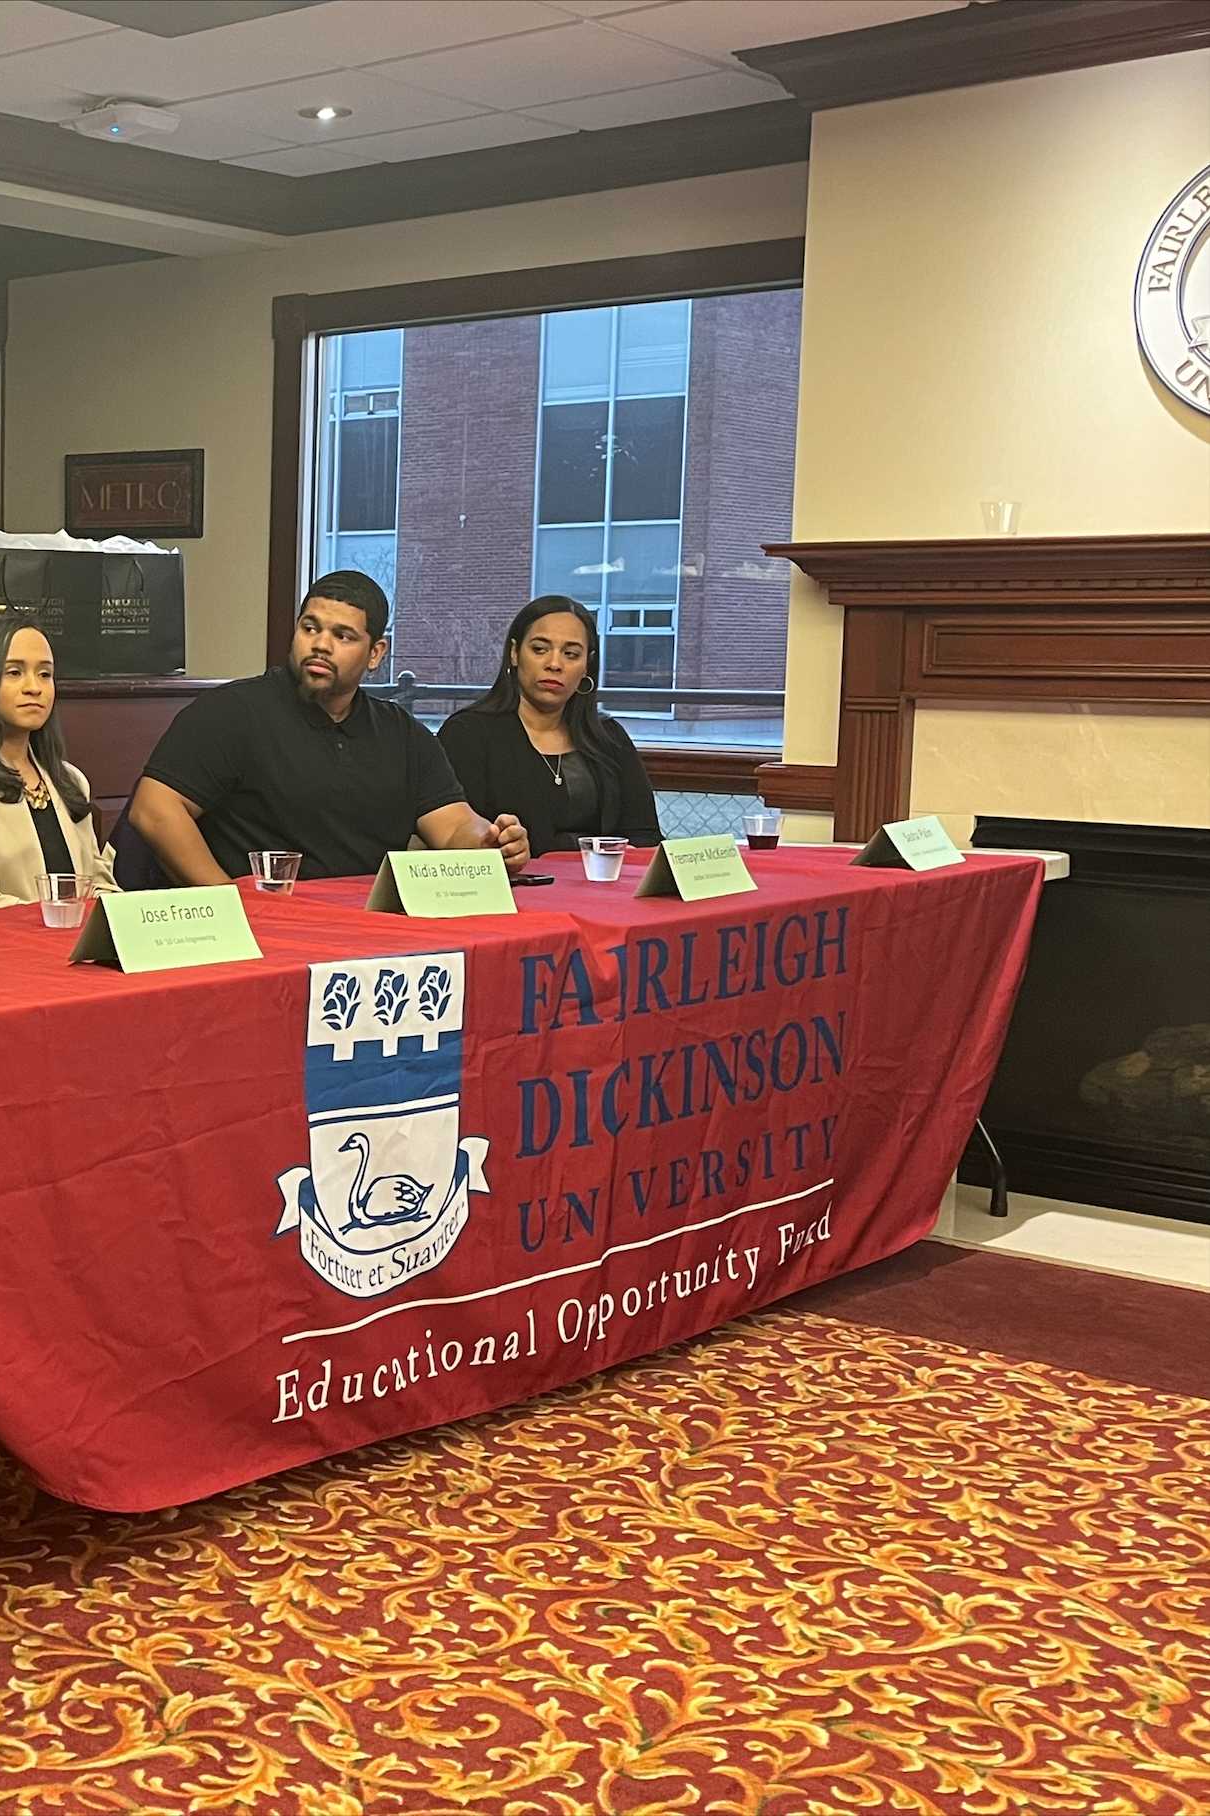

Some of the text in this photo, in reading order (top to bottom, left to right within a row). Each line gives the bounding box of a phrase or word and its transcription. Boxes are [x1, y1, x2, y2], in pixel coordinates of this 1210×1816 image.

[80, 481, 182, 513] METRO
[140, 904, 214, 924] Jose Franco
[409, 863, 493, 880] Nidia Rodriguez
[517, 906, 850, 1036] FAIRLEIGH
[516, 1010, 846, 1159] DICKINSON
[310, 1205, 460, 1290] Fortiter et Suaviter
[271, 1308, 538, 1423] Educational
[556, 1243, 761, 1352] Opportunity
